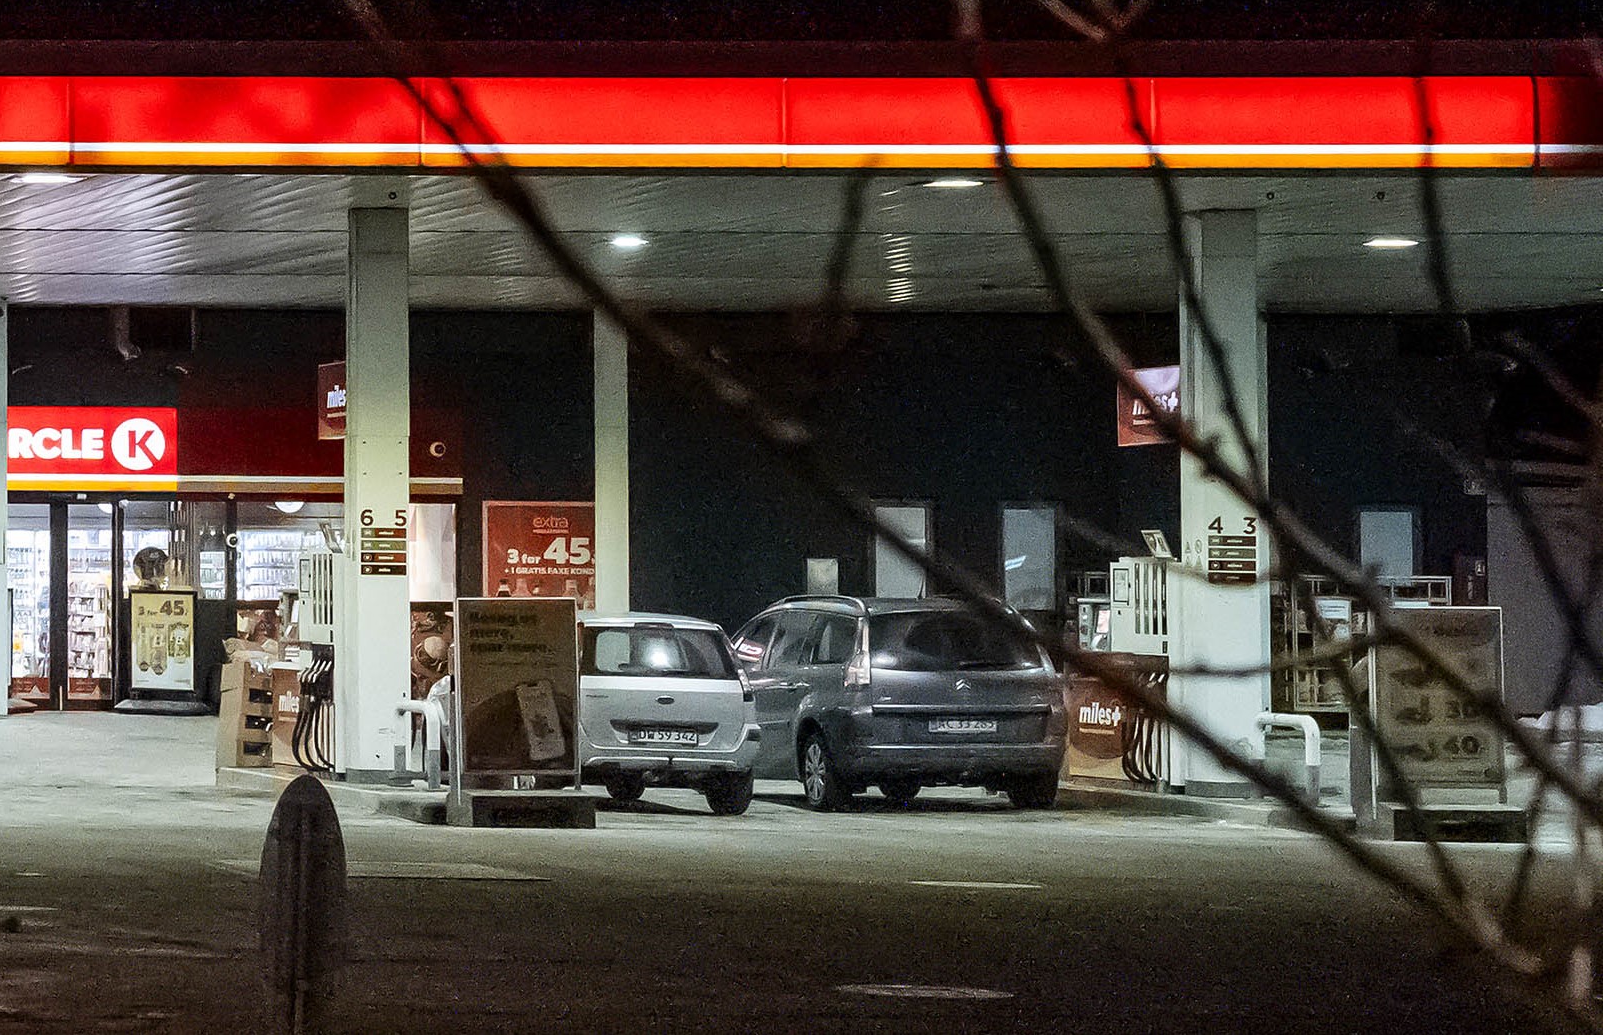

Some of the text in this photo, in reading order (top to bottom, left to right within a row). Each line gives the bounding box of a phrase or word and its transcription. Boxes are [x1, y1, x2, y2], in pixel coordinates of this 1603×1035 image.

[360, 509, 374, 527] 6
[394, 509, 407, 527] 5
[532, 515, 569, 528] extra
[1207, 516, 1224, 535] 4
[1242, 516, 1257, 535] 3
[507, 548, 520, 565] 3
[521, 553, 542, 565] for
[515, 567, 547, 575] GRATIS
